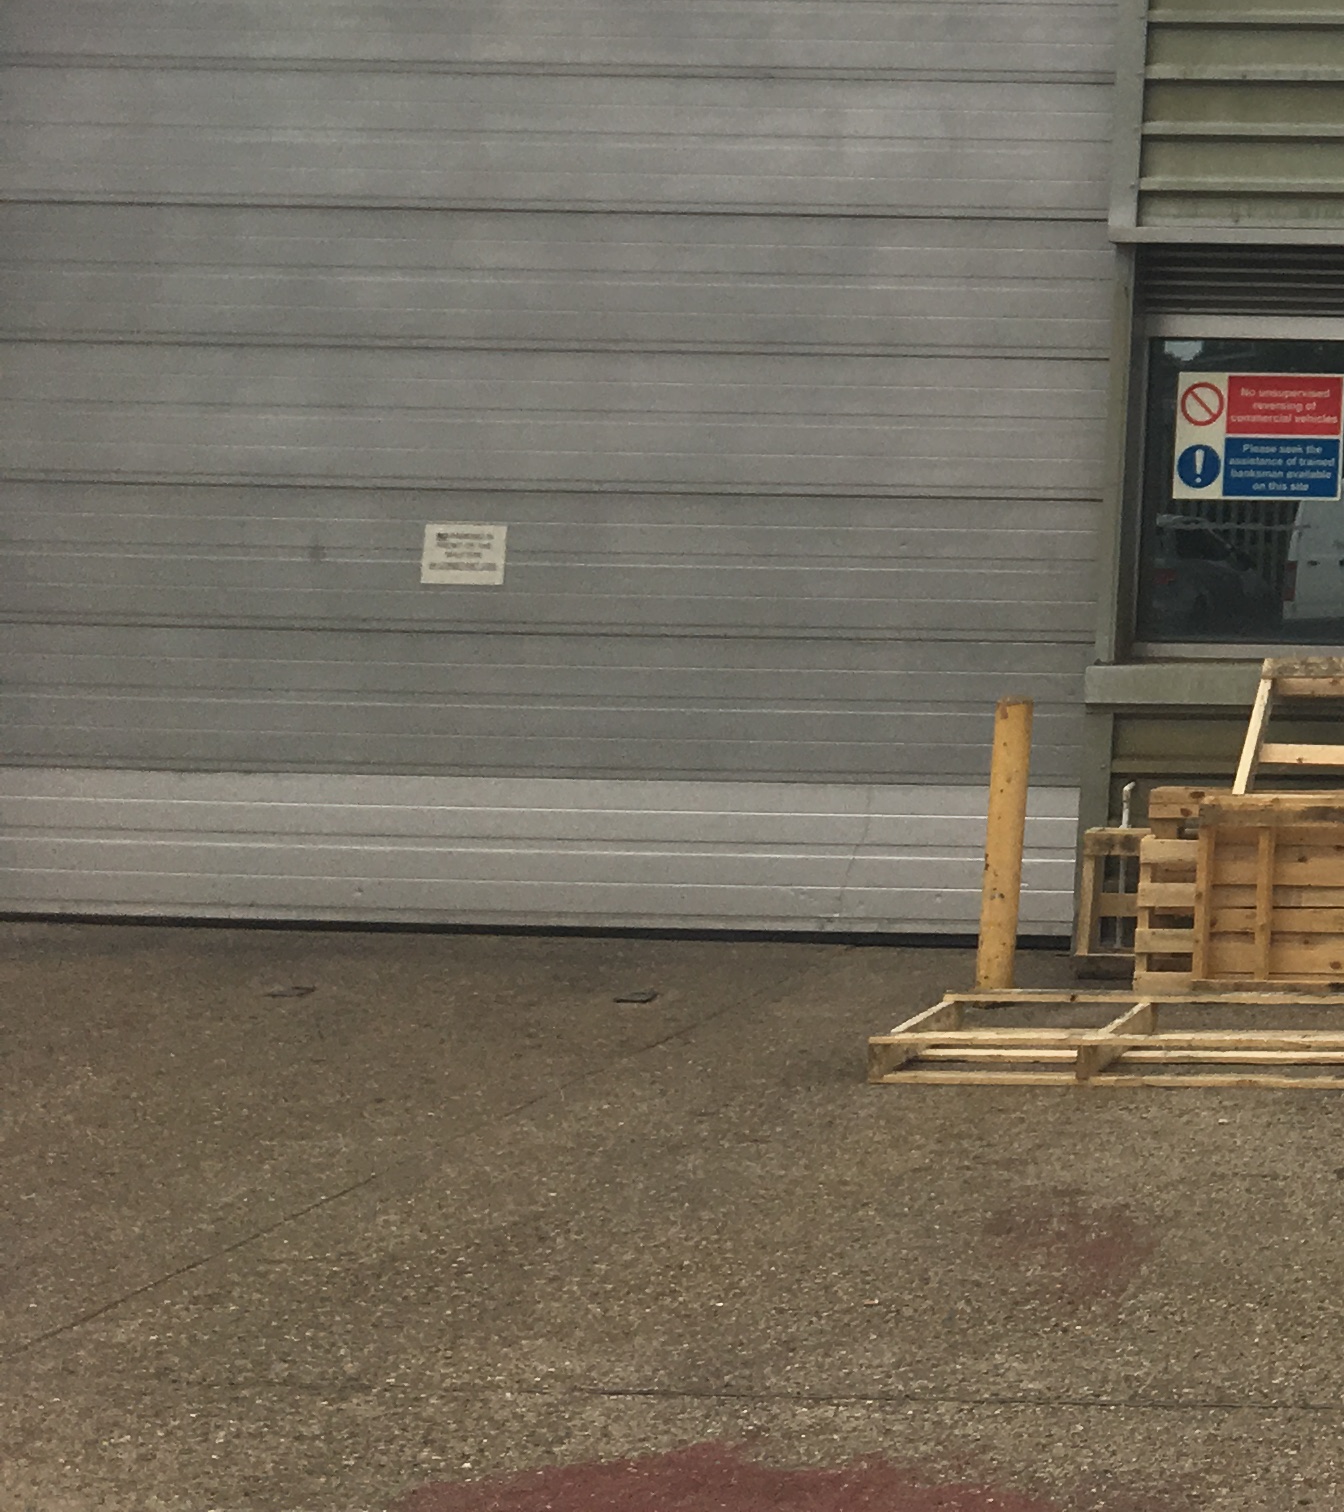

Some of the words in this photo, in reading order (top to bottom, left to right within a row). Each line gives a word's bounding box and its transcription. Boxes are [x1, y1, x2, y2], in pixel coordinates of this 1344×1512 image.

[1240, 387, 1256, 396] No
[1259, 389, 1330, 398] unsupervised
[1252, 403, 1303, 413] reversing
[1305, 402, 1316, 410] of
[1231, 414, 1292, 422] commercial
[1295, 414, 1337, 423] vehicles
[1243, 444, 1277, 453] Please
[1279, 445, 1303, 453] seek
[1306, 445, 1322, 453] the
[1229, 457, 1283, 465] assistance
[1286, 457, 1297, 466] of
[1299, 458, 1335, 466] trained
[1286, 470, 1331, 478] available
[1268, 481, 1287, 490] this
[1290, 483, 1309, 491] site
